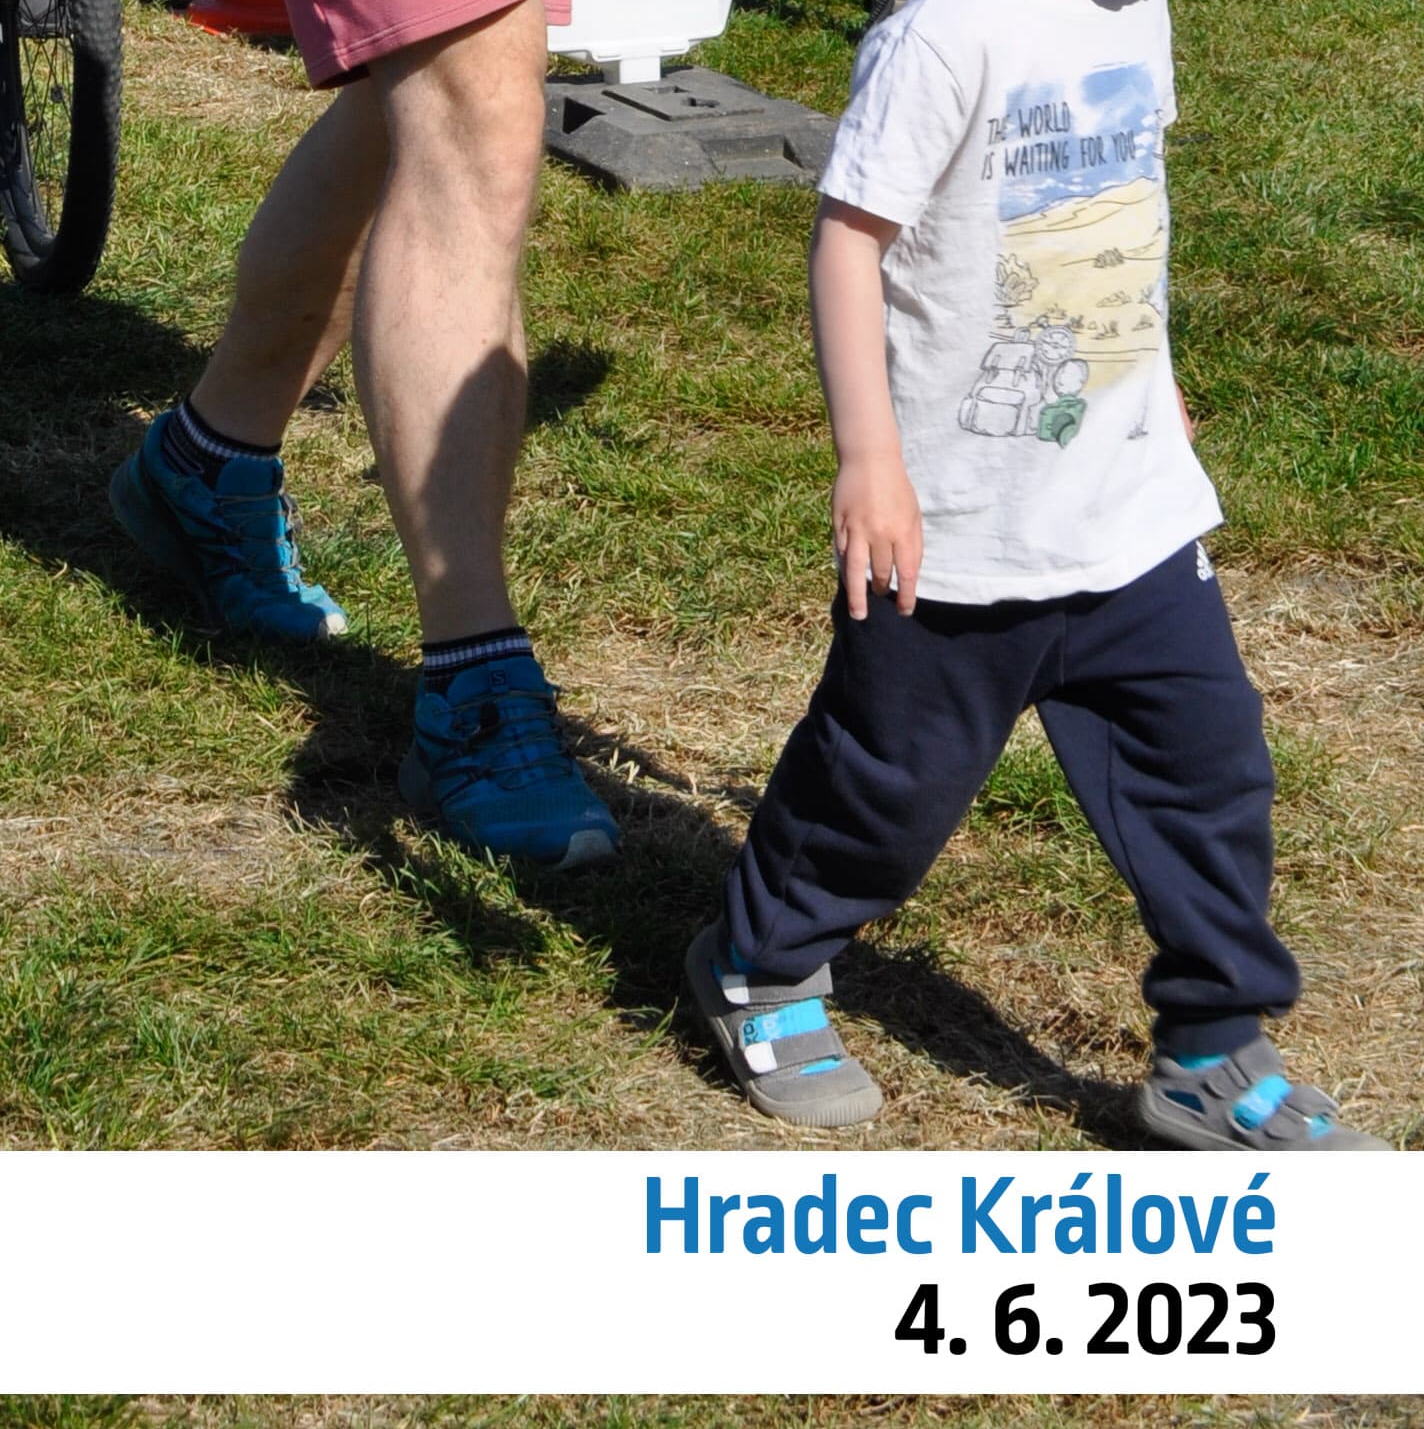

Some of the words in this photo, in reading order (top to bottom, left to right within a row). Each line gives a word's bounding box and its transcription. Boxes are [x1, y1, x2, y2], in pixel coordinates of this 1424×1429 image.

[988, 113, 1010, 146] THE
[1018, 101, 1072, 139] WORLD
[981, 151, 995, 181] IS
[1004, 140, 1070, 177] WAITING
[1079, 135, 1108, 169] FOR
[1111, 129, 1138, 162] YOU
